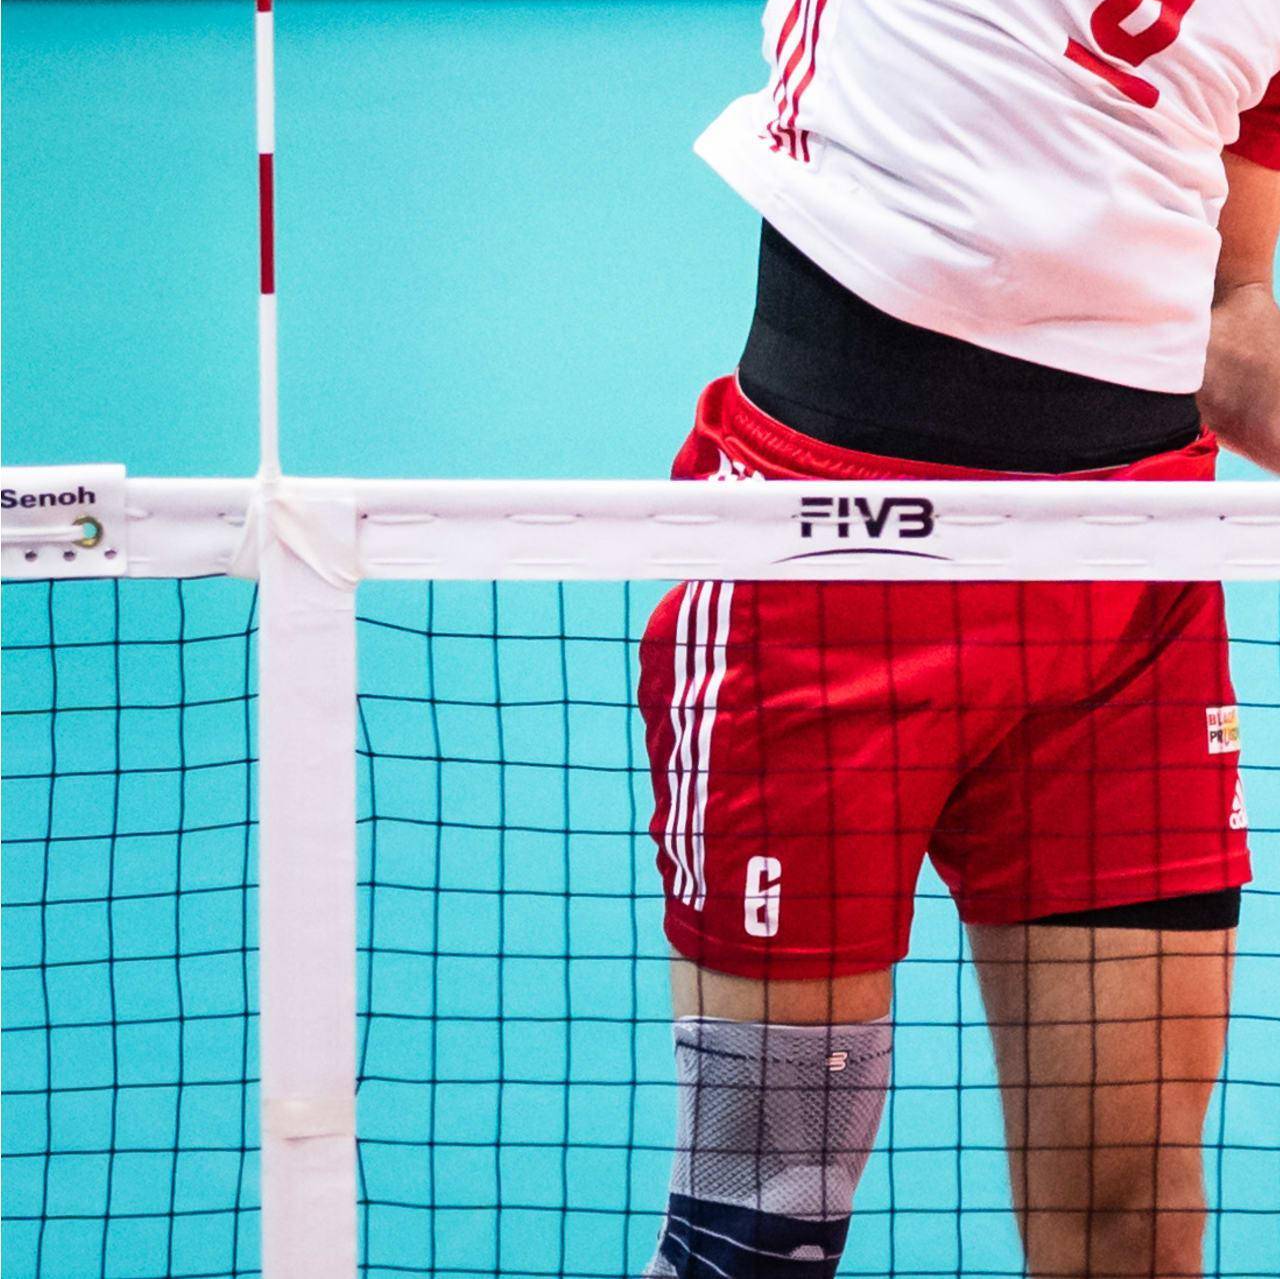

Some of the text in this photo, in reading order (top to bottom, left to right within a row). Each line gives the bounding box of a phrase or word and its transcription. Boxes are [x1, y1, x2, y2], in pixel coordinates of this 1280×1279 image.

[0, 486, 96, 509] Senoh
[801, 497, 935, 538] FIVB
[744, 855, 782, 937] 6
